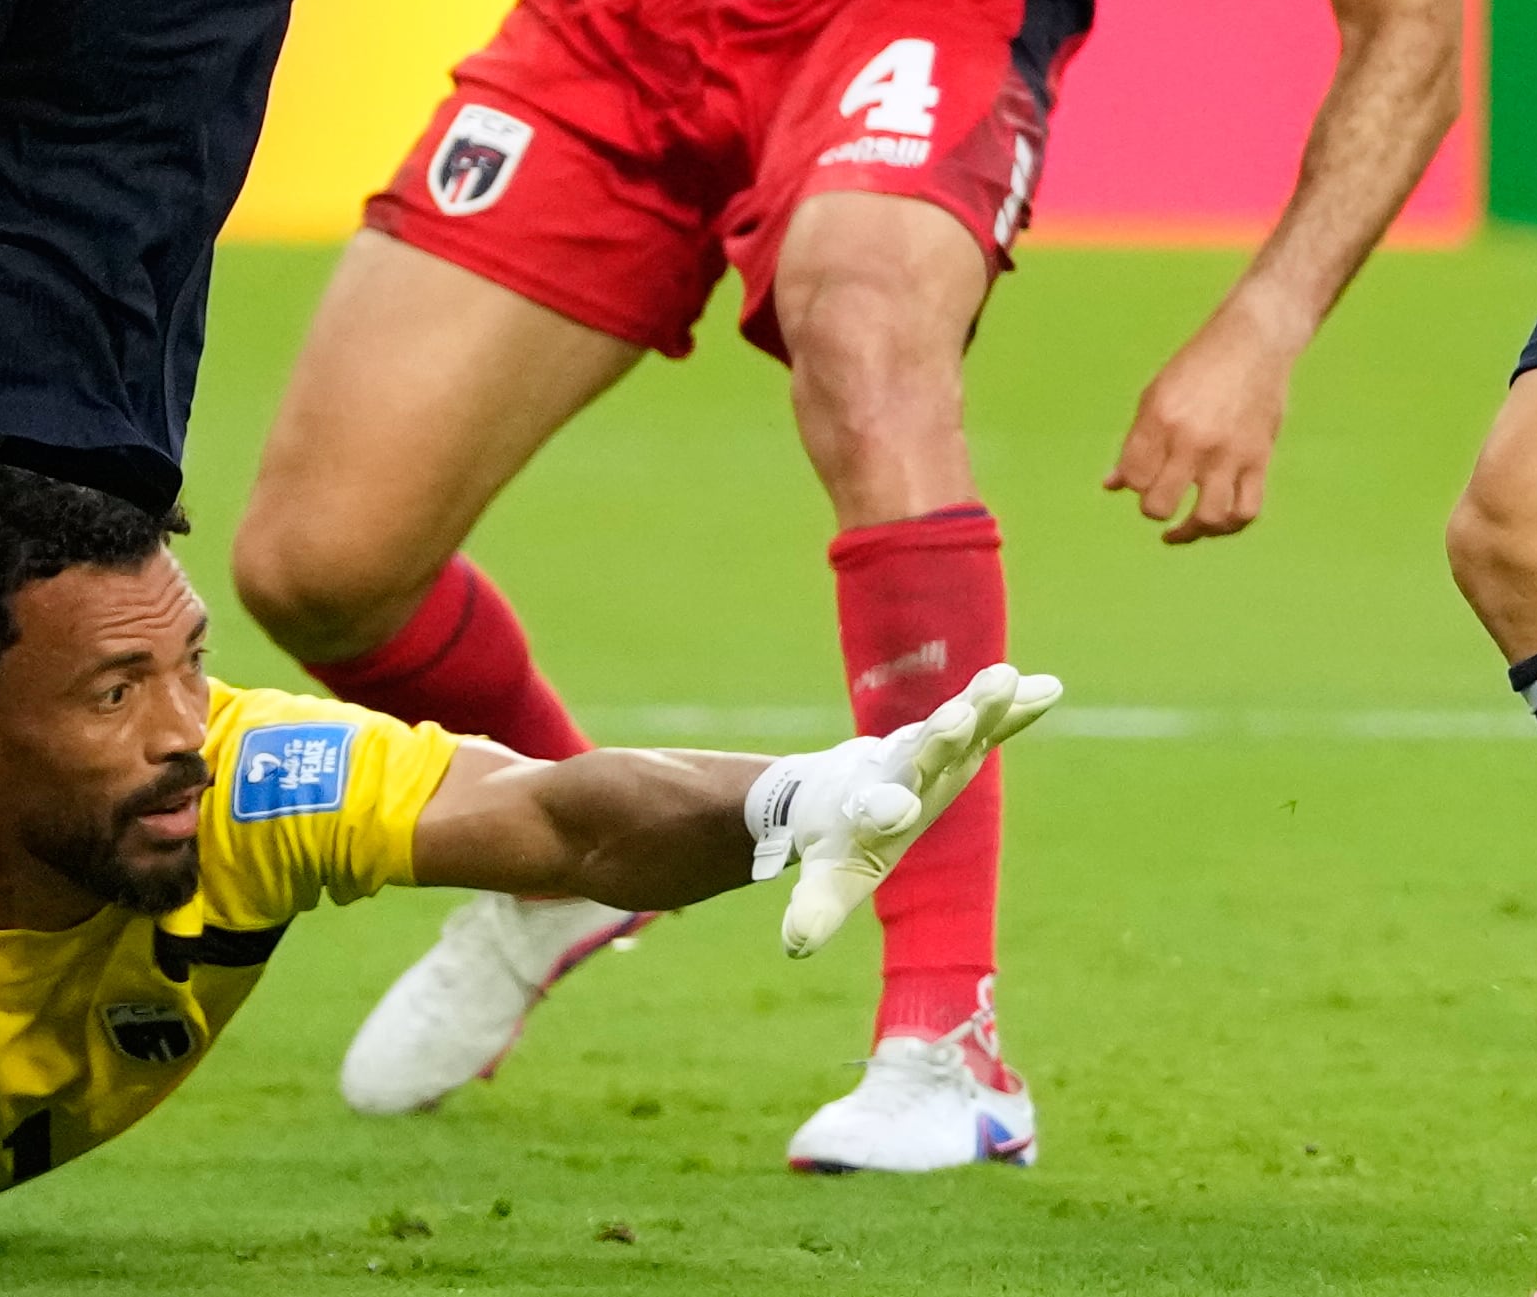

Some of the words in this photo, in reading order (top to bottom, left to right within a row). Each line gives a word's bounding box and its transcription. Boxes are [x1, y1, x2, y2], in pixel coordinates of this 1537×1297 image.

[839, 37, 940, 137] 4
[299, 739, 327, 783] PEACE
[3, 1108, 52, 1179] 1
